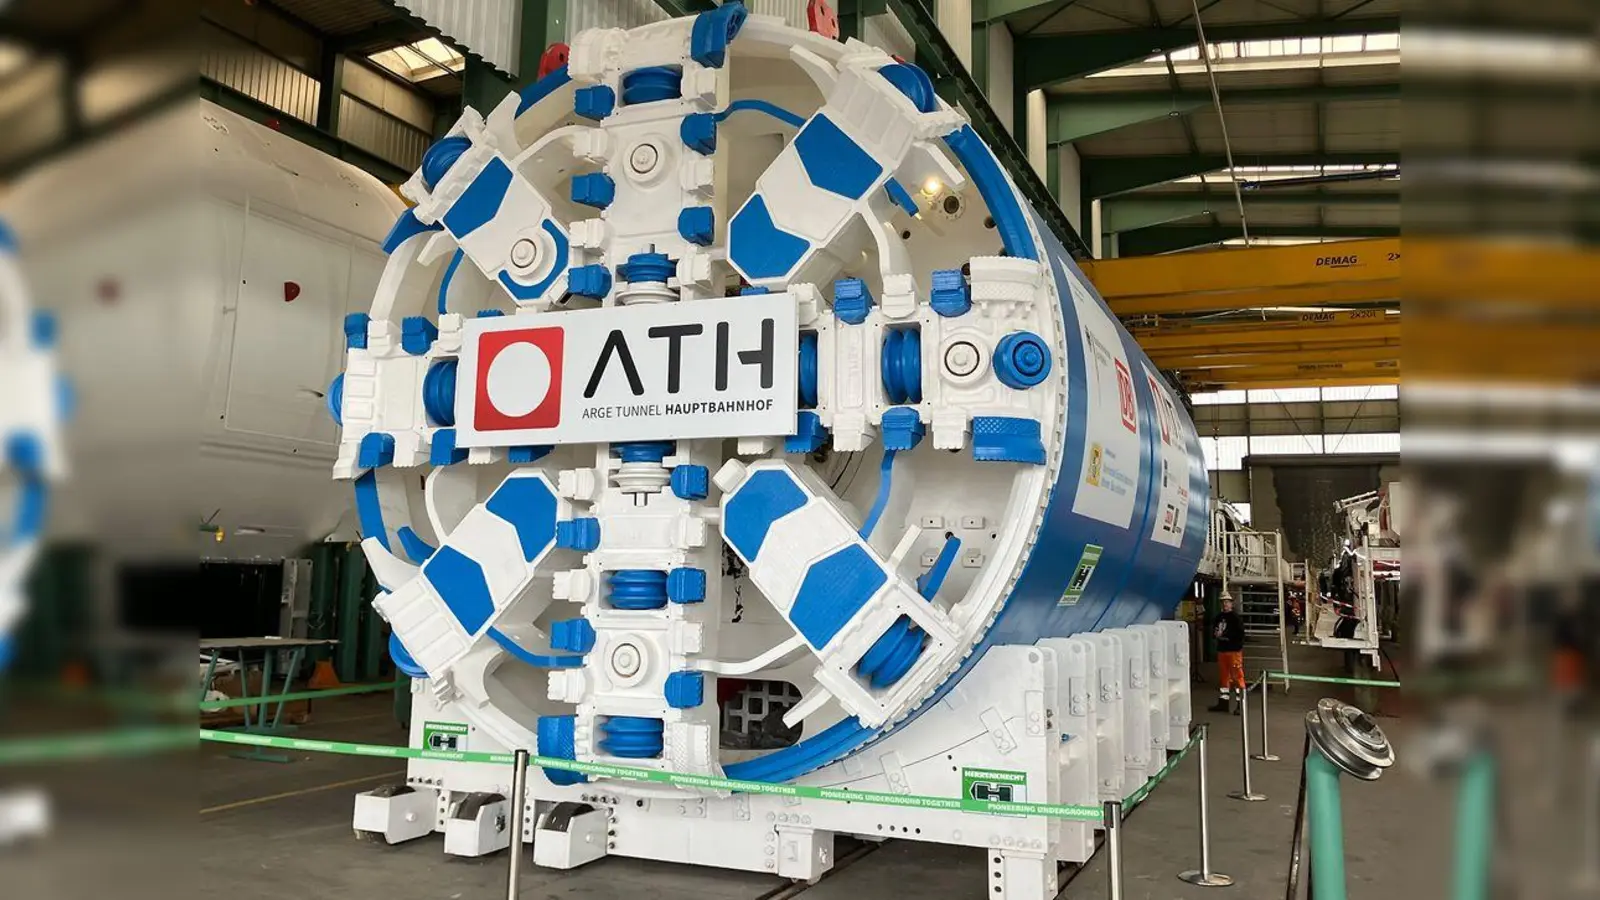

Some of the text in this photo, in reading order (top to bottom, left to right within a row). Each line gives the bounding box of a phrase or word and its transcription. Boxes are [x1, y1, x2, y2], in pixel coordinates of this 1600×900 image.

[1315, 255, 1358, 266] DEMAG
[1302, 312, 1335, 321] DEMAG
[583, 318, 774, 398] ATH
[582, 399, 773, 419] ARGE TUNNEL HAUPTBAHNHOF
[617, 769, 649, 778] TOGETHER
[964, 770, 1025, 782] HERRENKNECHT
[670, 775, 796, 794] PIONEERING UNDERGROUND TOGETHER
[820, 790, 961, 808] PIONEERING UNDERGROUND TOGETHER
[987, 803, 1036, 813] PIONEERING
[1037, 805, 1100, 817] UNDERGROUND
